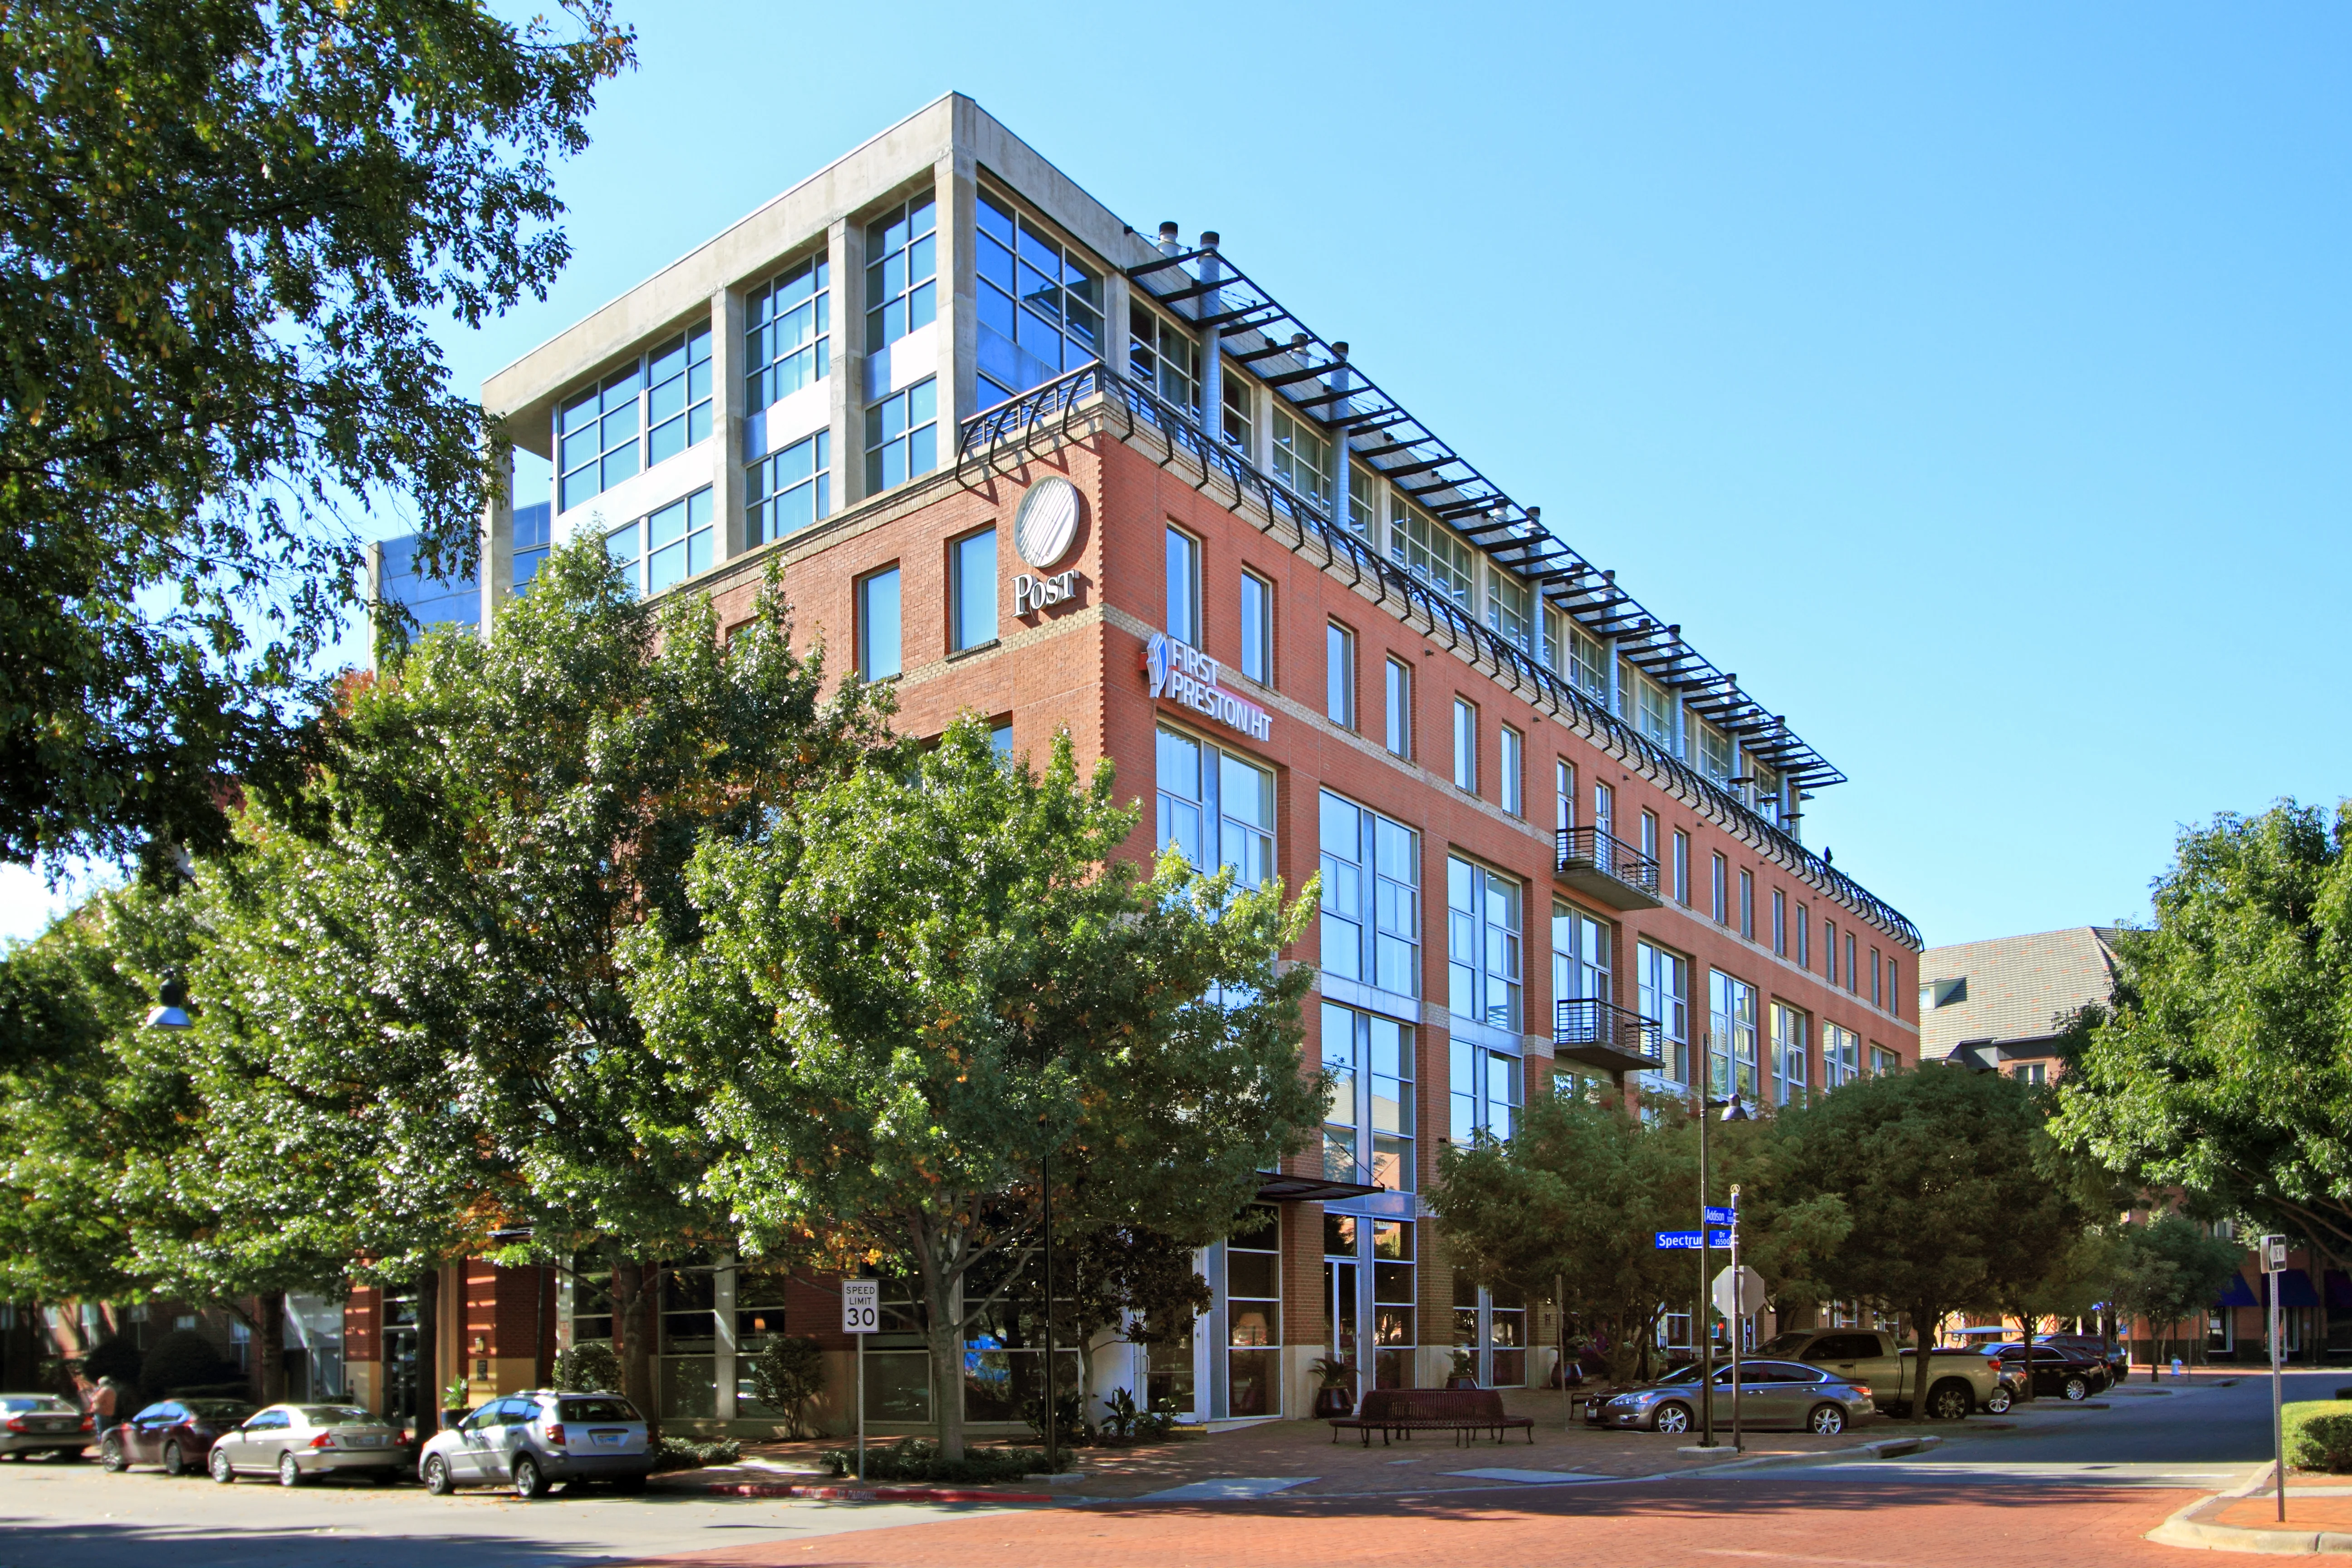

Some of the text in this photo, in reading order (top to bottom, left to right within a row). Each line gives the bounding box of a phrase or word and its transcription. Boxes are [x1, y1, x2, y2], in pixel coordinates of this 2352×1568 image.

[1171, 638, 1220, 687] FIRST
[1171, 670, 1273, 742] PRESTON HT
[1706, 1209, 1725, 1221] Addison
[846, 1286, 875, 1294] SPEED
[847, 1308, 875, 1327] 30
[837, 1490, 845, 1498] NO
[847, 1490, 877, 1499] PARKING
